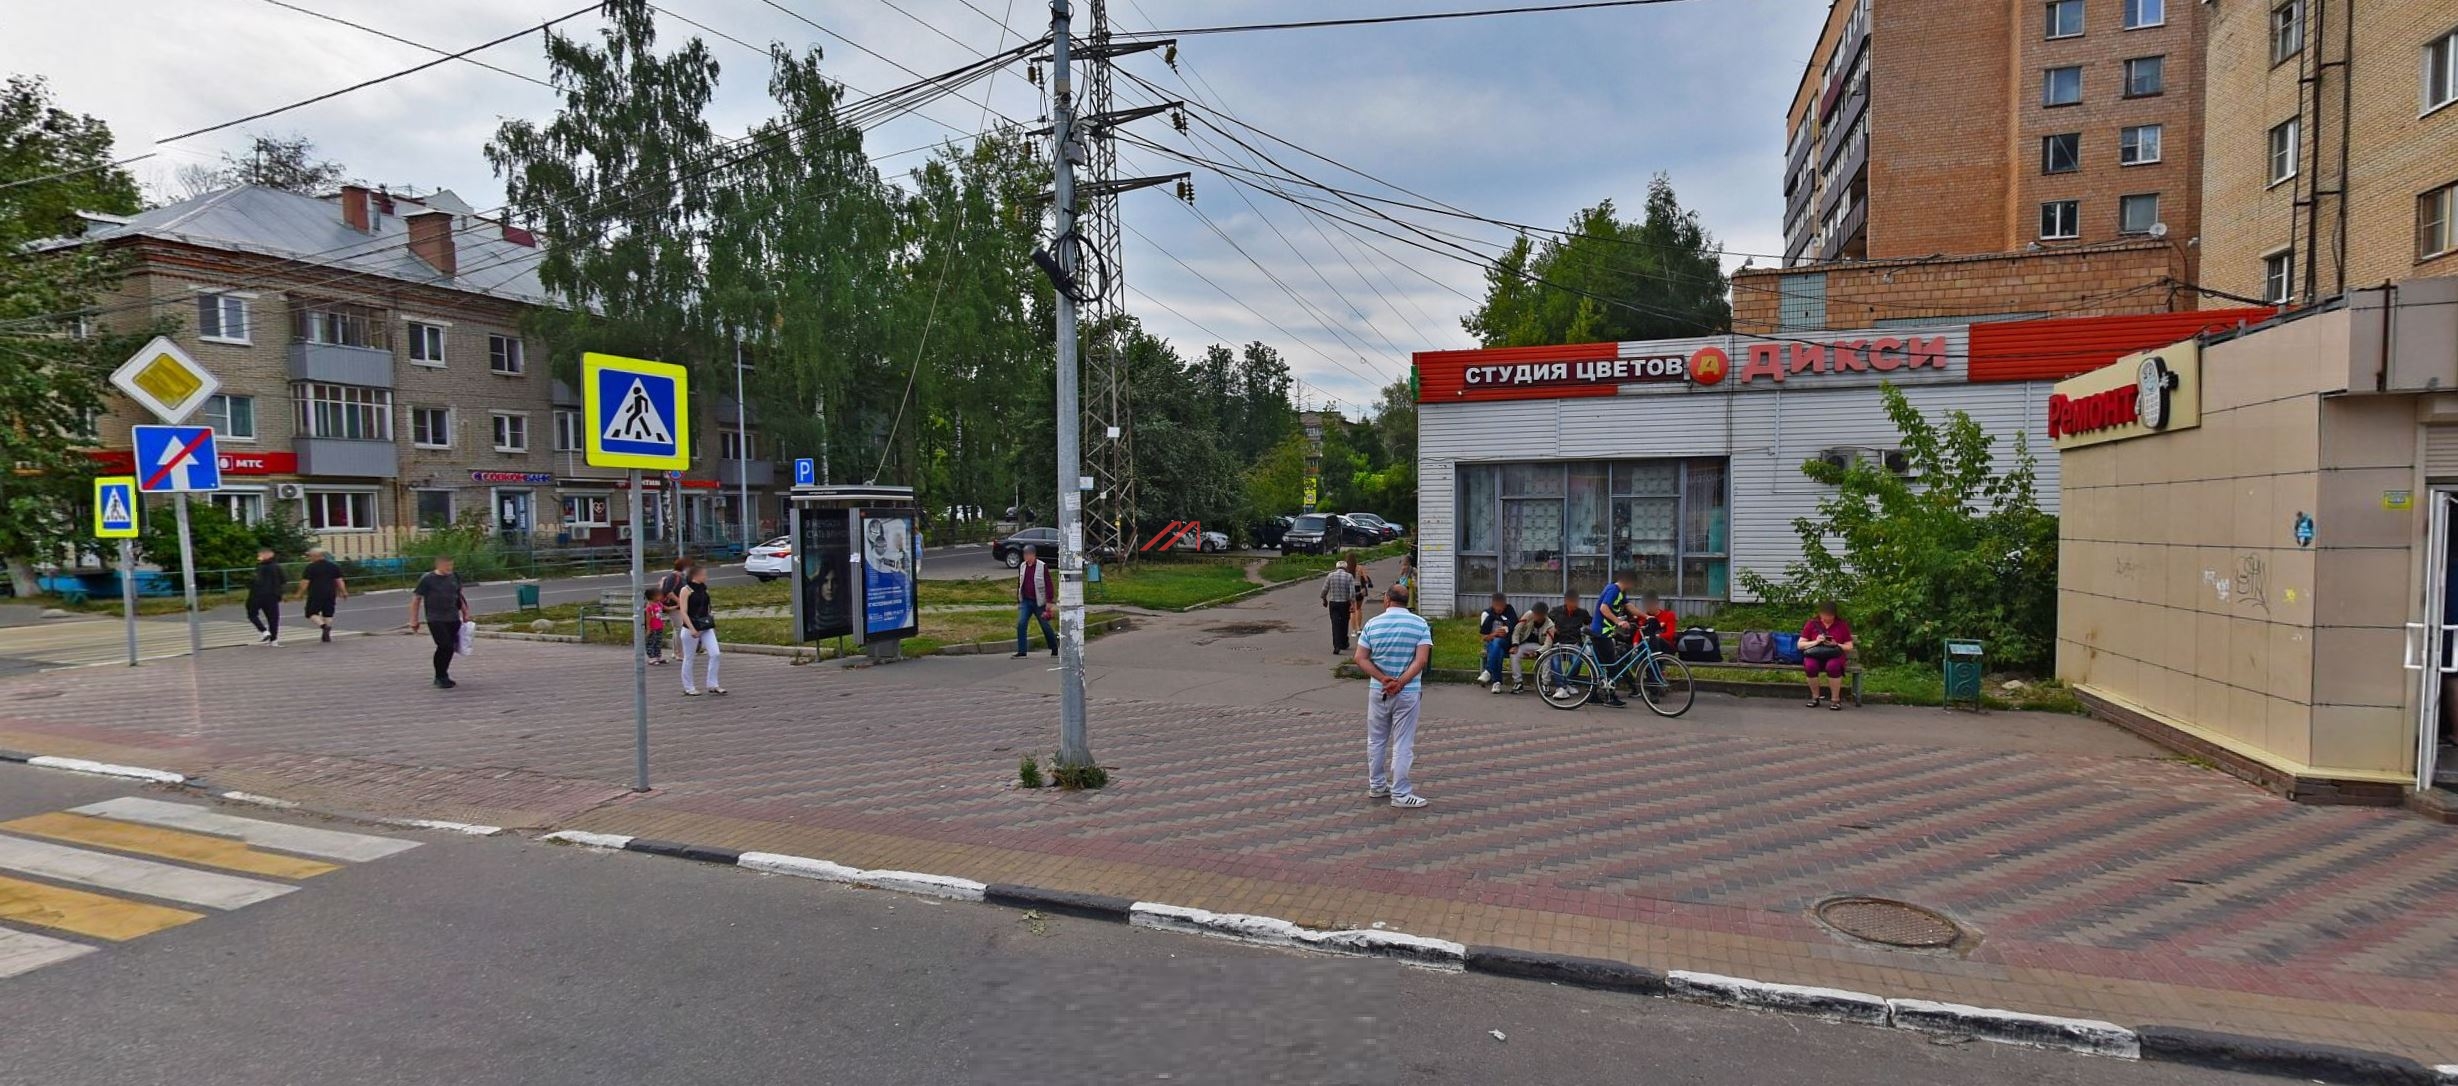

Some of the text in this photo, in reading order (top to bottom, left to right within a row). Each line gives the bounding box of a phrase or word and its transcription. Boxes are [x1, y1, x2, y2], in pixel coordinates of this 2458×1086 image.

[1465, 357, 1683, 385] СТУДИЯ ЦВЕТОВ
[1741, 336, 1947, 384] ДИКСИ
[236, 459, 264, 469] МТС
[800, 461, 811, 481] P
